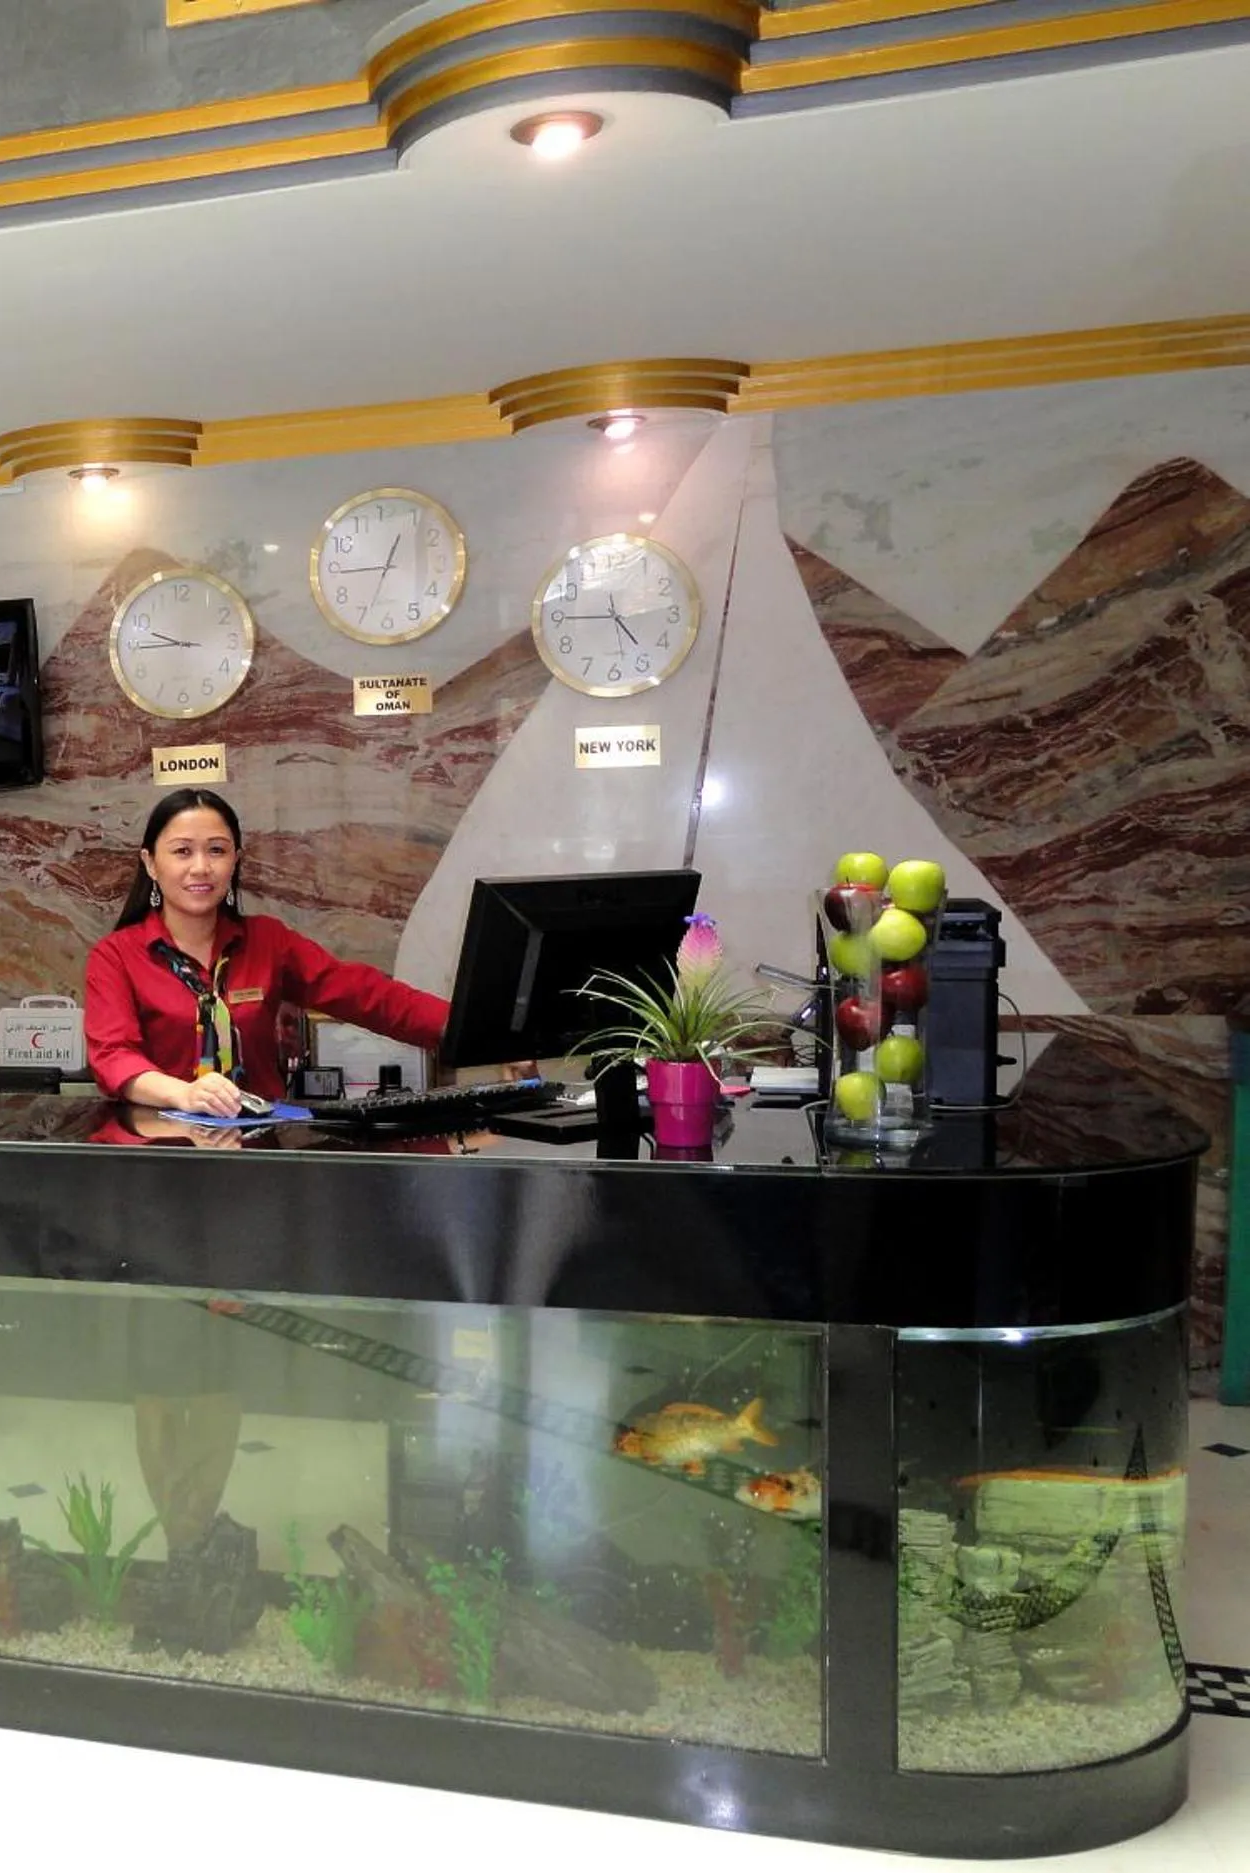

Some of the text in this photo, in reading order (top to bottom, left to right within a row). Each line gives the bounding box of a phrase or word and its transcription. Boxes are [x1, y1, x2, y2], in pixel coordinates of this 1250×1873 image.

[427, 529, 440, 547] 2
[641, 557, 647, 575] 1
[172, 585, 190, 601] 12
[336, 587, 348, 604] 8
[425, 581, 438, 598] 4
[558, 583, 577, 601] 10
[658, 578, 671, 596] 2
[218, 608, 231, 625] 2
[356, 606, 367, 624] 7
[407, 602, 420, 620] 5
[551, 610, 564, 628] 9
[668, 605, 680, 624] 3
[133, 613, 150, 630] 10
[381, 612, 394, 629] 6
[227, 633, 239, 650] 3
[559, 636, 572, 654] 8
[656, 631, 670, 650] 4
[218, 657, 230, 677] 4
[581, 657, 593, 676] 7
[635, 654, 650, 672] 5
[608, 663, 622, 681] 6
[202, 678, 214, 695] 5
[359, 677, 427, 689] SULTANATE
[178, 687, 189, 703] 6
[385, 690, 401, 699] OF
[376, 700, 410, 711] OMAN
[579, 739, 656, 754] NEW YORK
[160, 757, 219, 772] LONDON
[8, 1048, 70, 1059] First aid kit
